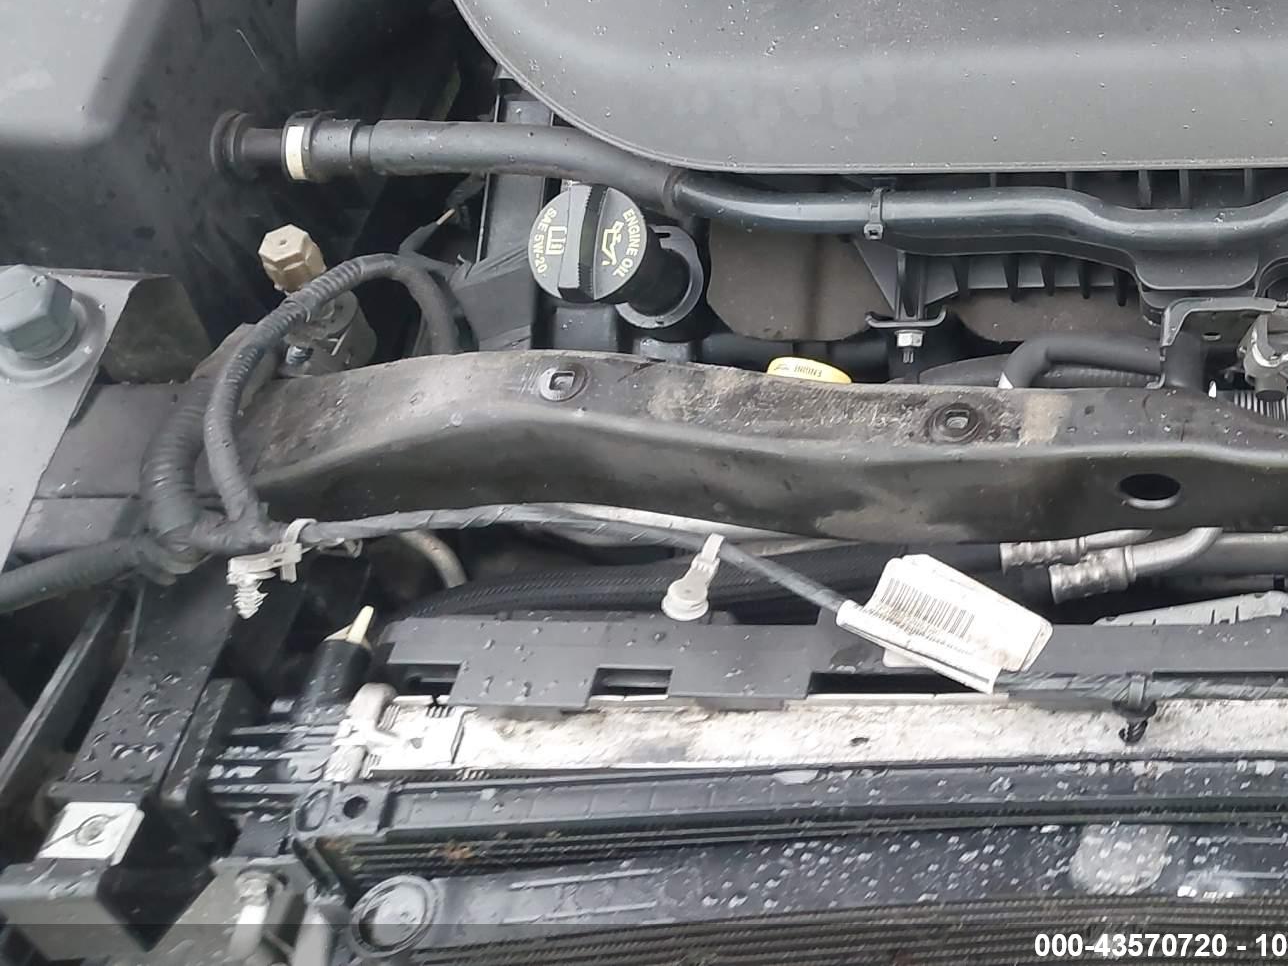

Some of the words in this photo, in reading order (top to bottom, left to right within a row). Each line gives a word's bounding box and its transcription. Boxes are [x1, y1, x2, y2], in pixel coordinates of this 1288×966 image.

[536, 206, 558, 233] SAE
[621, 207, 642, 257] ENGINE
[532, 234, 549, 275] 5W-20
[611, 258, 635, 278] OIL
